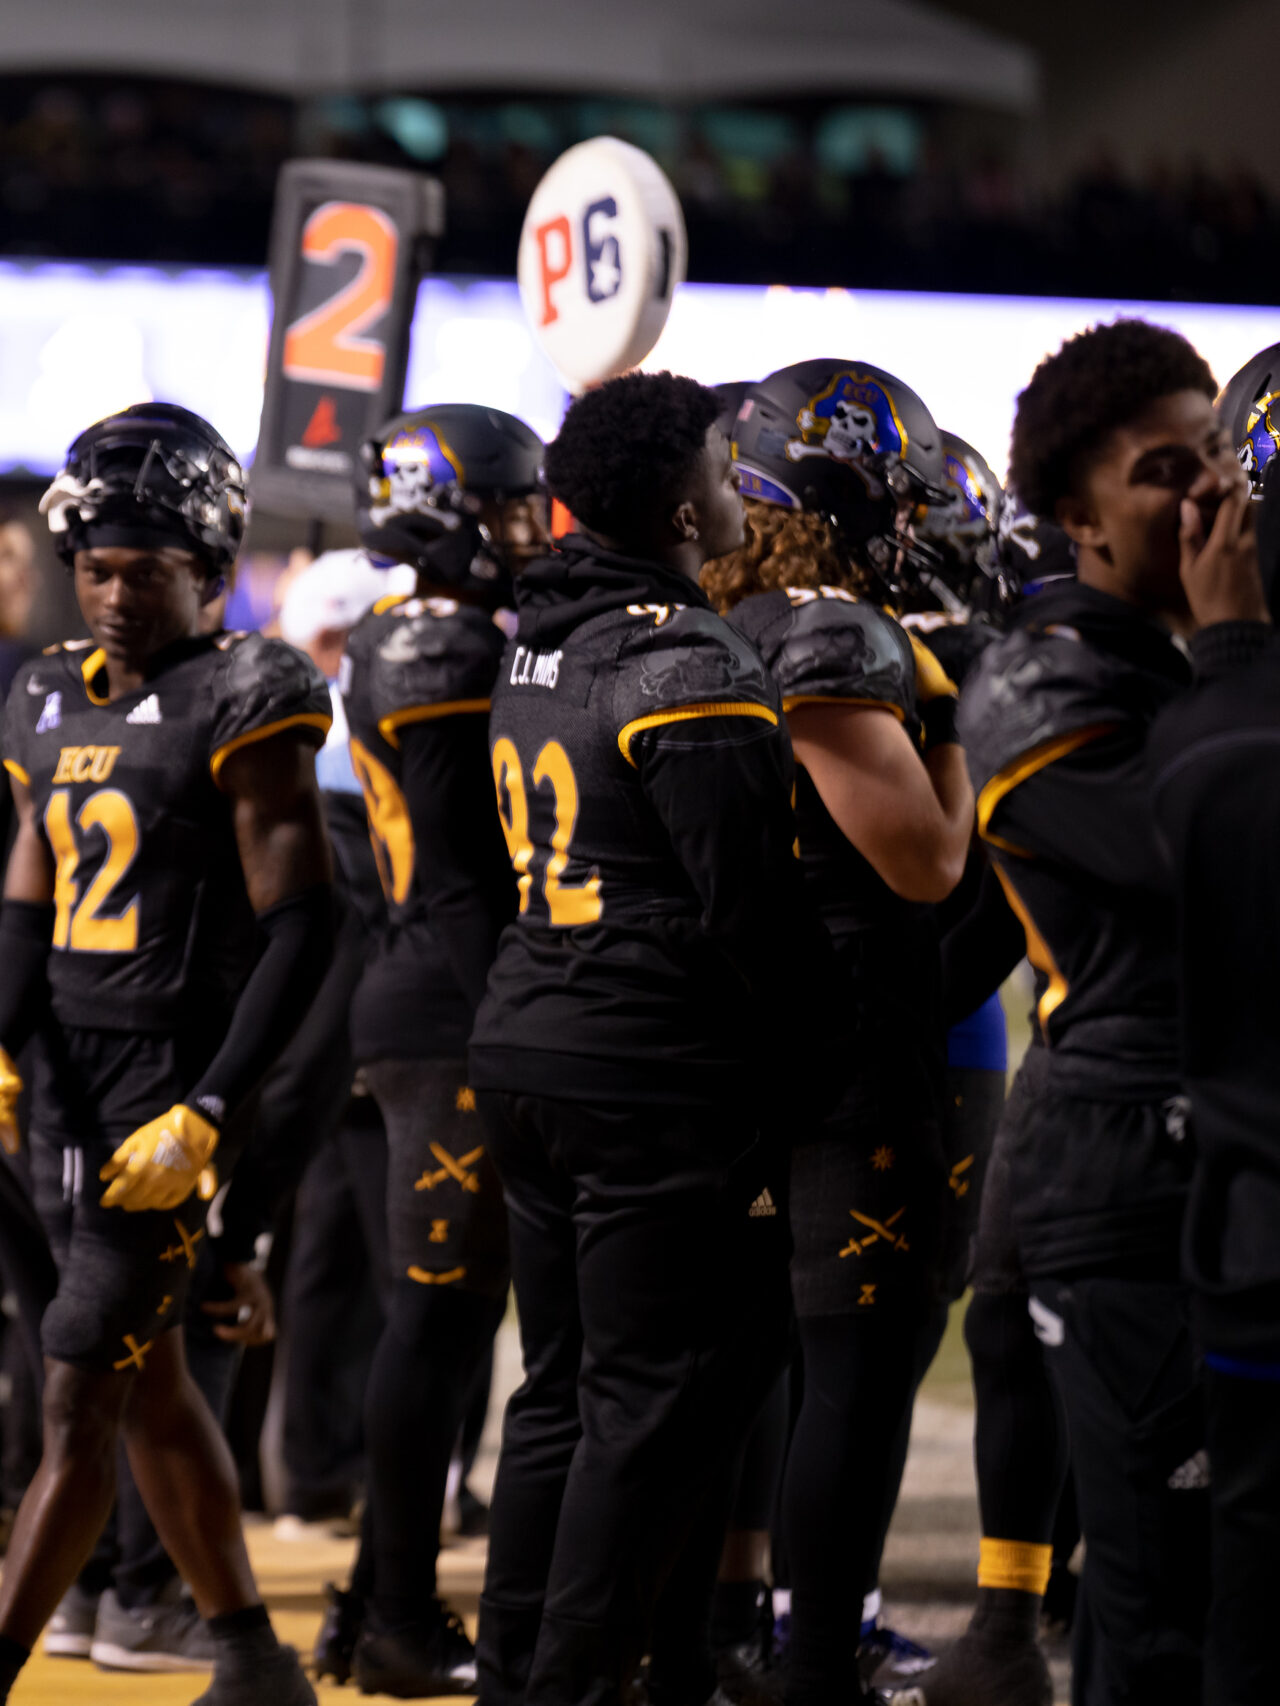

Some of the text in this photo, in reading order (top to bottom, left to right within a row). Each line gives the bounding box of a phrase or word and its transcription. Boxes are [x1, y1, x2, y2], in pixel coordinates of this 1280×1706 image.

[282, 201, 399, 391] 2
[537, 195, 622, 326] P6
[51, 745, 122, 784] ECU
